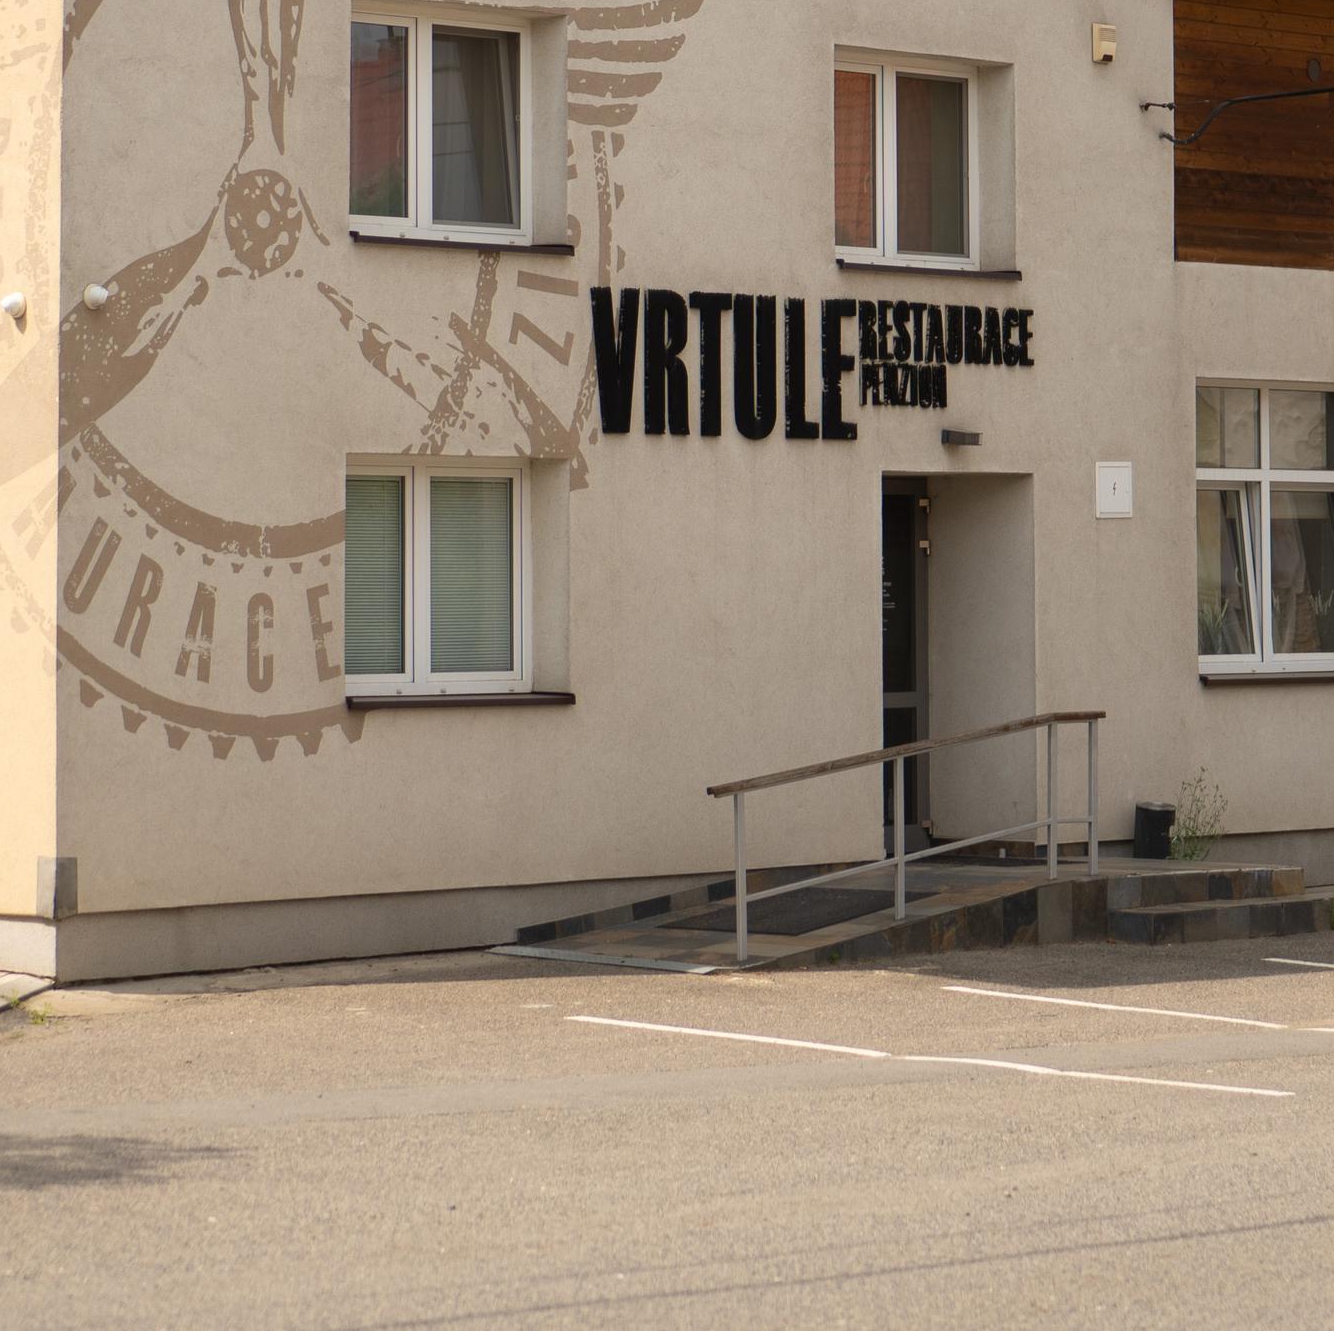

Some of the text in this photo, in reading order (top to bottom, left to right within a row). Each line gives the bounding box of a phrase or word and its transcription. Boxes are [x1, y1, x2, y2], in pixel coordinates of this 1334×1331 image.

[590, 286, 858, 440] VRTULE
[858, 300, 1035, 366] RESTAURACE
[859, 362, 948, 408] PENZION
